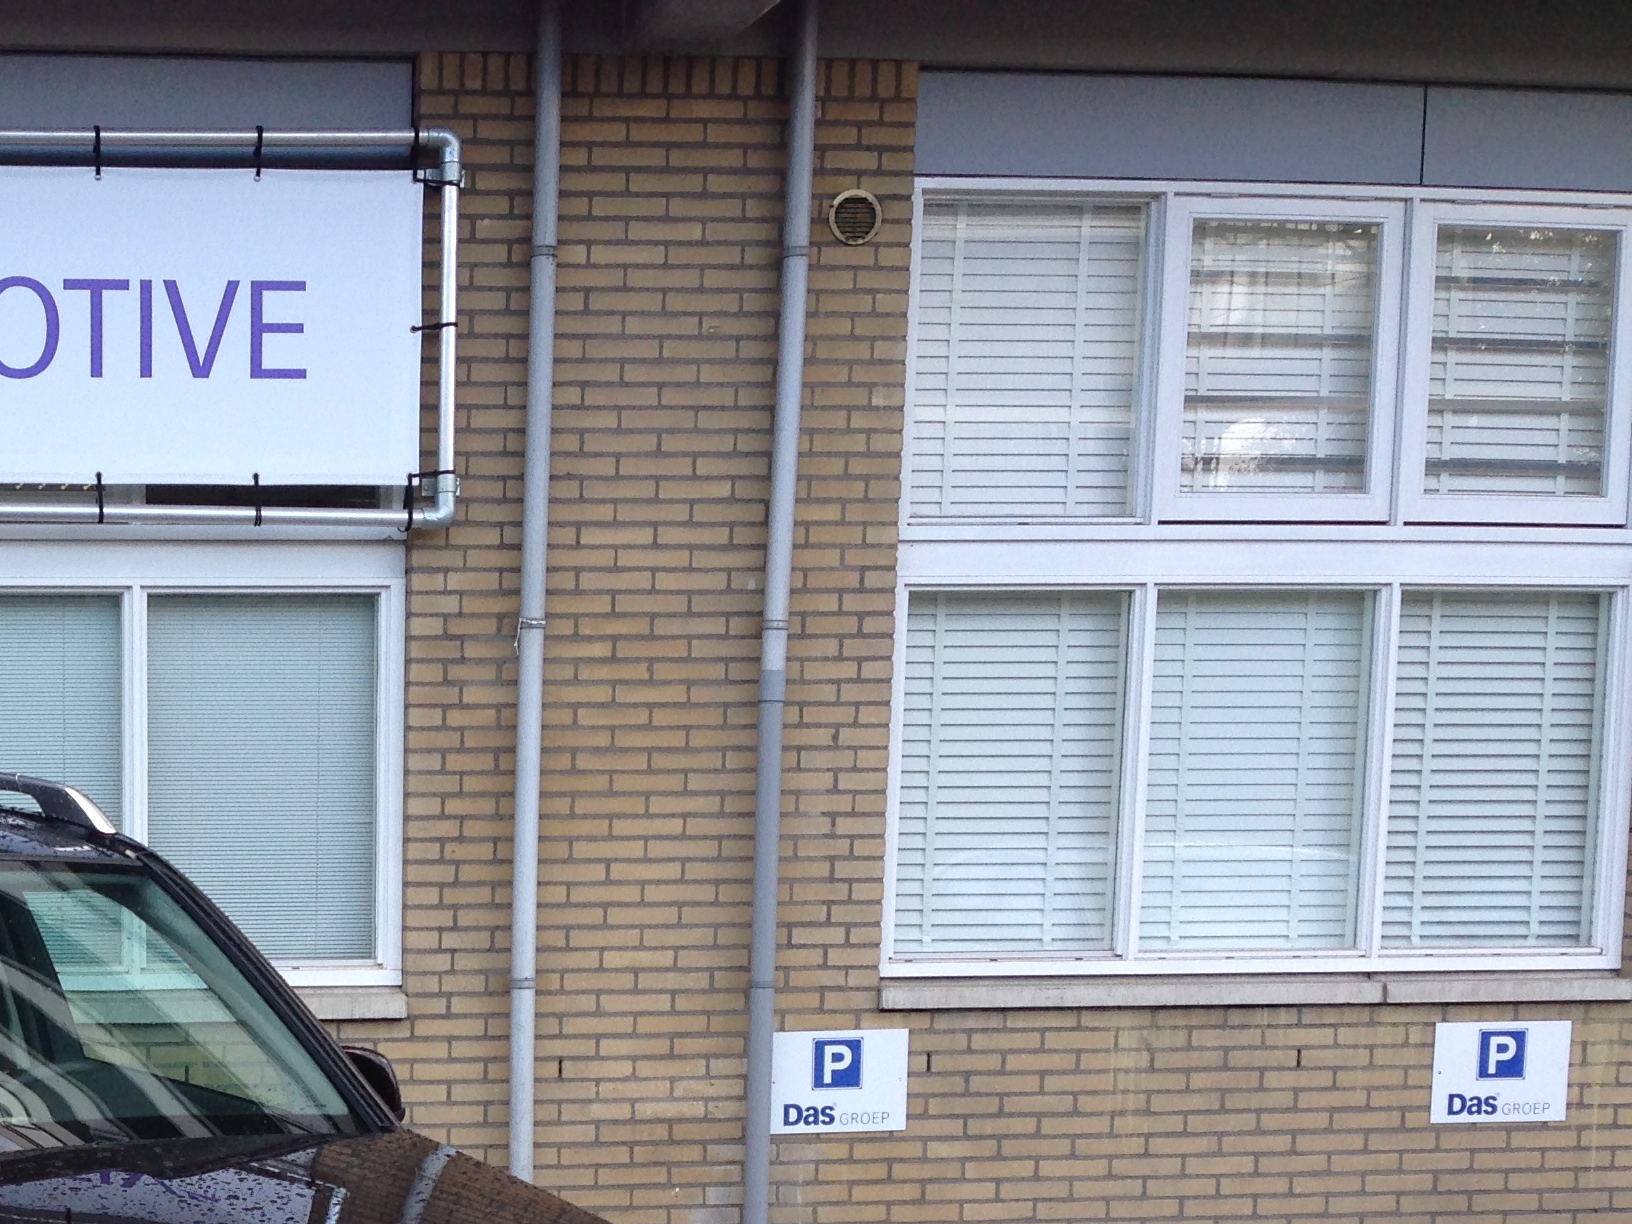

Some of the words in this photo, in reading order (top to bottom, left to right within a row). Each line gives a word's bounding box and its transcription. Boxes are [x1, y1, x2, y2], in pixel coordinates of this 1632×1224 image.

[823, 1044, 853, 1084] P
[1487, 1035, 1517, 1075] P
[783, 1103, 836, 1127] Das
[839, 1111, 890, 1126] GROEP
[1447, 1093, 1498, 1116] Das
[1501, 1102, 1551, 1116] GROEP
